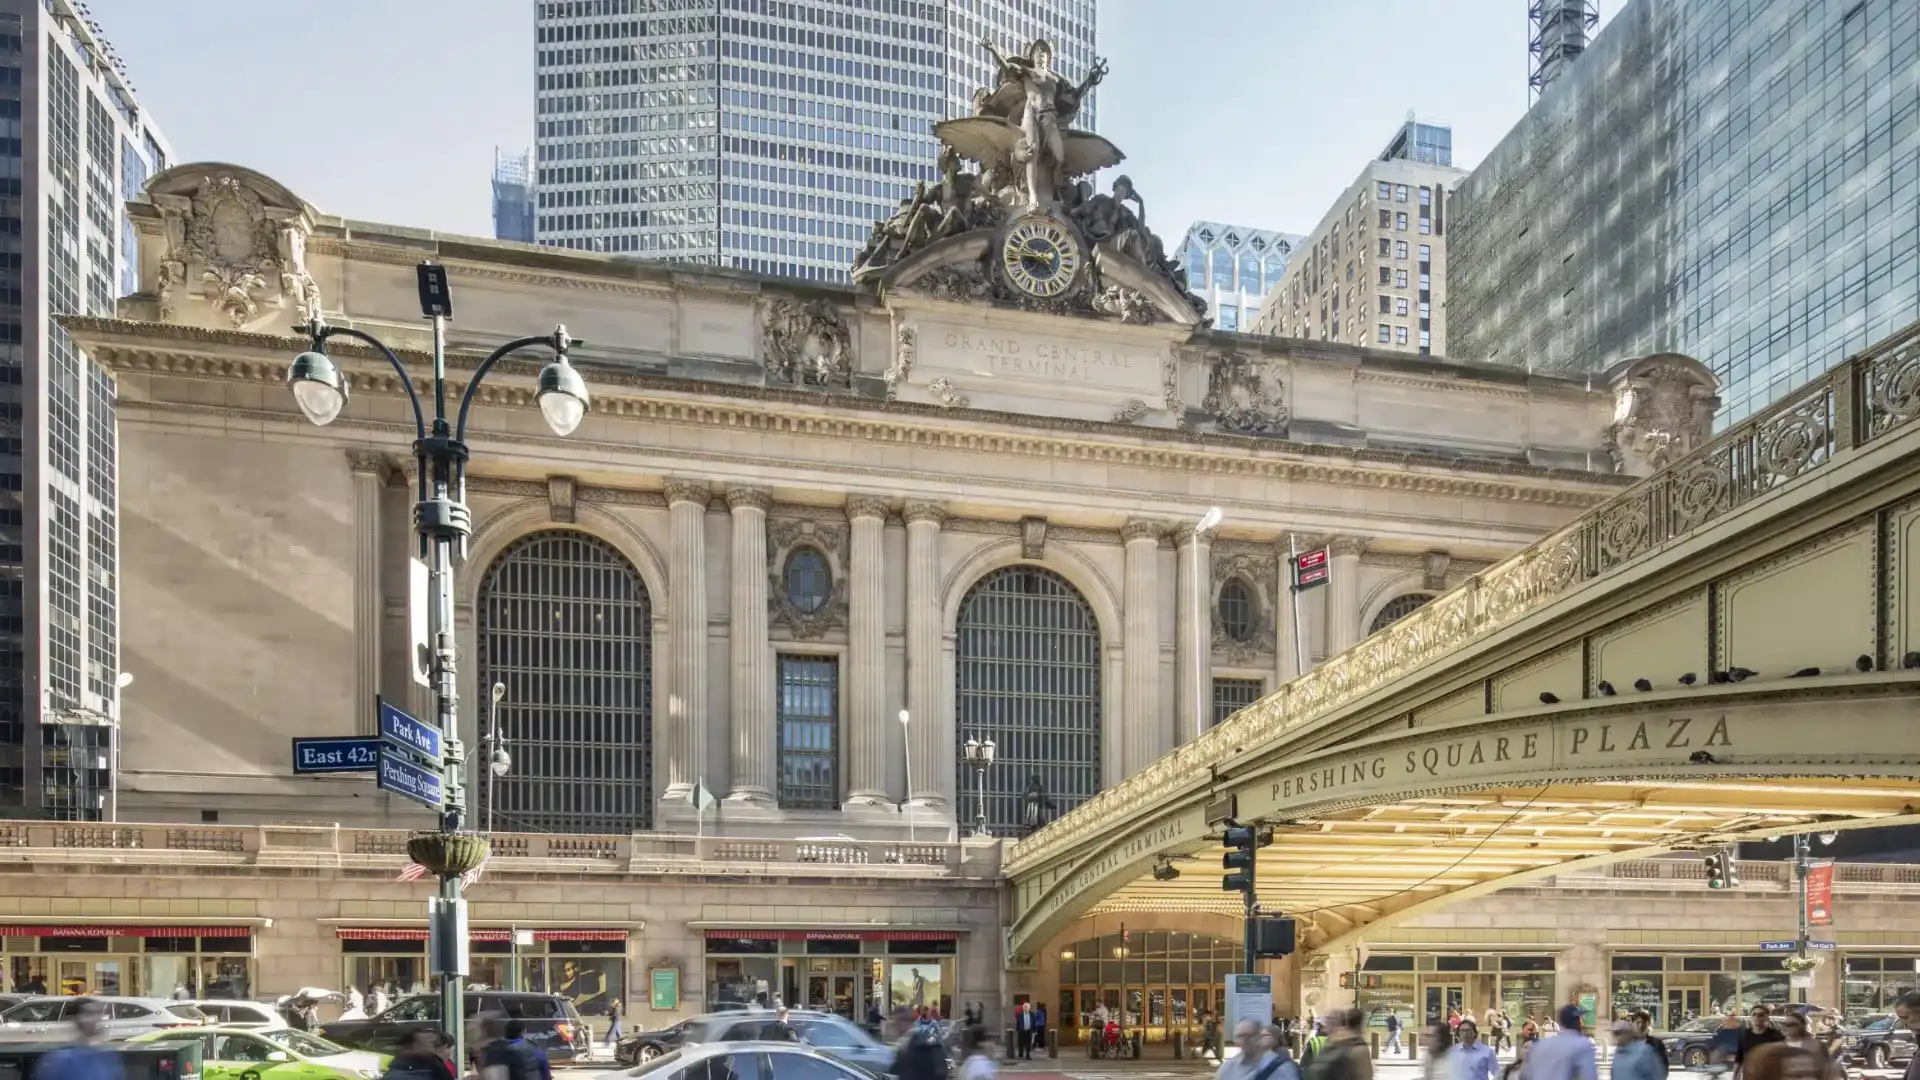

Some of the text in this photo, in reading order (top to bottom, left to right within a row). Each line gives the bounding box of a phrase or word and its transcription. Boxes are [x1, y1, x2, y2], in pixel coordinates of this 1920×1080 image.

[944, 333, 1132, 368] GRAND CENTRAL
[986, 355, 1094, 380] TERMINAL
[392, 715, 431, 750] Park Ave
[302, 748, 344, 764] East
[347, 747, 377, 763] 42n
[1271, 714, 1733, 801] PERSHING SQUARE PLAZA
[383, 760, 441, 797] Pershing Square
[1050, 820, 1183, 910] GRAND CENTRAL TERMINAL
[53, 928, 124, 936] BANANA REPUBLIC
